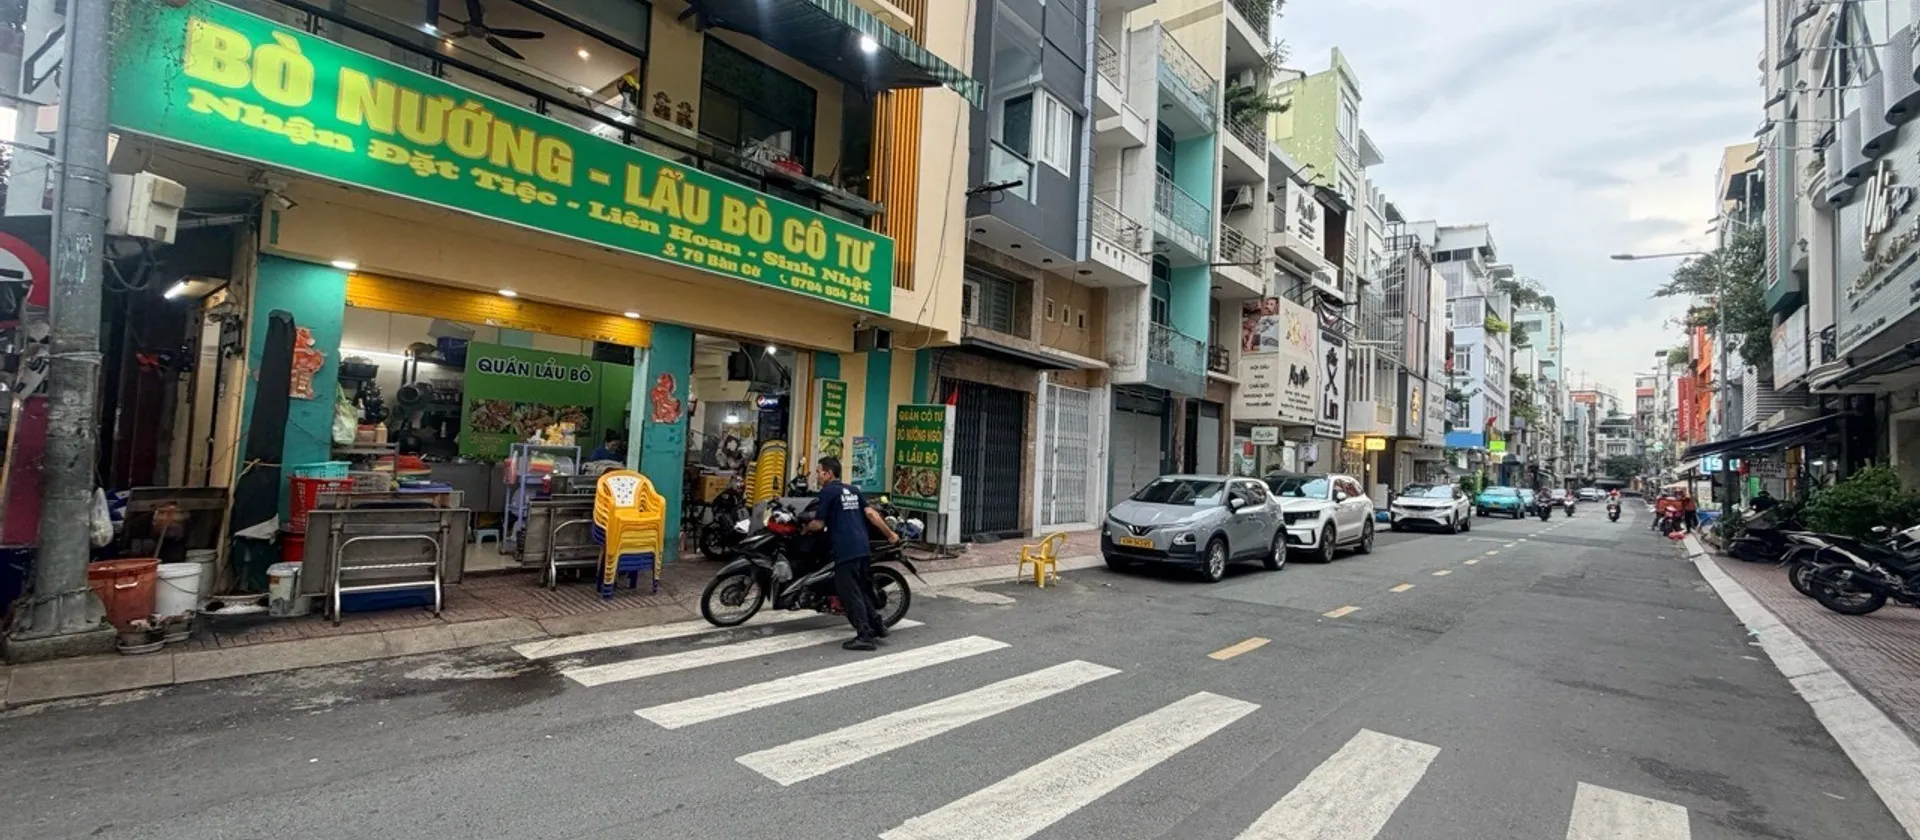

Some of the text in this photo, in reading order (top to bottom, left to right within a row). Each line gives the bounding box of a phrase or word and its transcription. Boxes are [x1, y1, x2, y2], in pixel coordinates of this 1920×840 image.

[185, 18, 314, 107] BÒ
[337, 67, 574, 186] NƯỚNG
[624, 163, 711, 226] LẨU
[720, 196, 773, 245] BÒ
[783, 218, 828, 260] CÔ
[836, 232, 875, 273] TƯ
[188, 88, 354, 152] Nhận
[368, 139, 460, 179] Đặt
[470, 167, 557, 206] Tiệc
[588, 201, 661, 235] Liên
[669, 223, 742, 257] Hoan
[762, 250, 816, 277] Sinh
[822, 266, 872, 292] Nhật
[706, 253, 738, 273] Bàn
[740, 262, 762, 279] Cờ
[476, 356, 592, 383] QUÁN LẨU BÒ
[898, 408, 919, 422] QUÁN
[920, 408, 933, 422] CÔ
[906, 444, 924, 464] LẨU
[925, 449, 939, 465] BÒ
